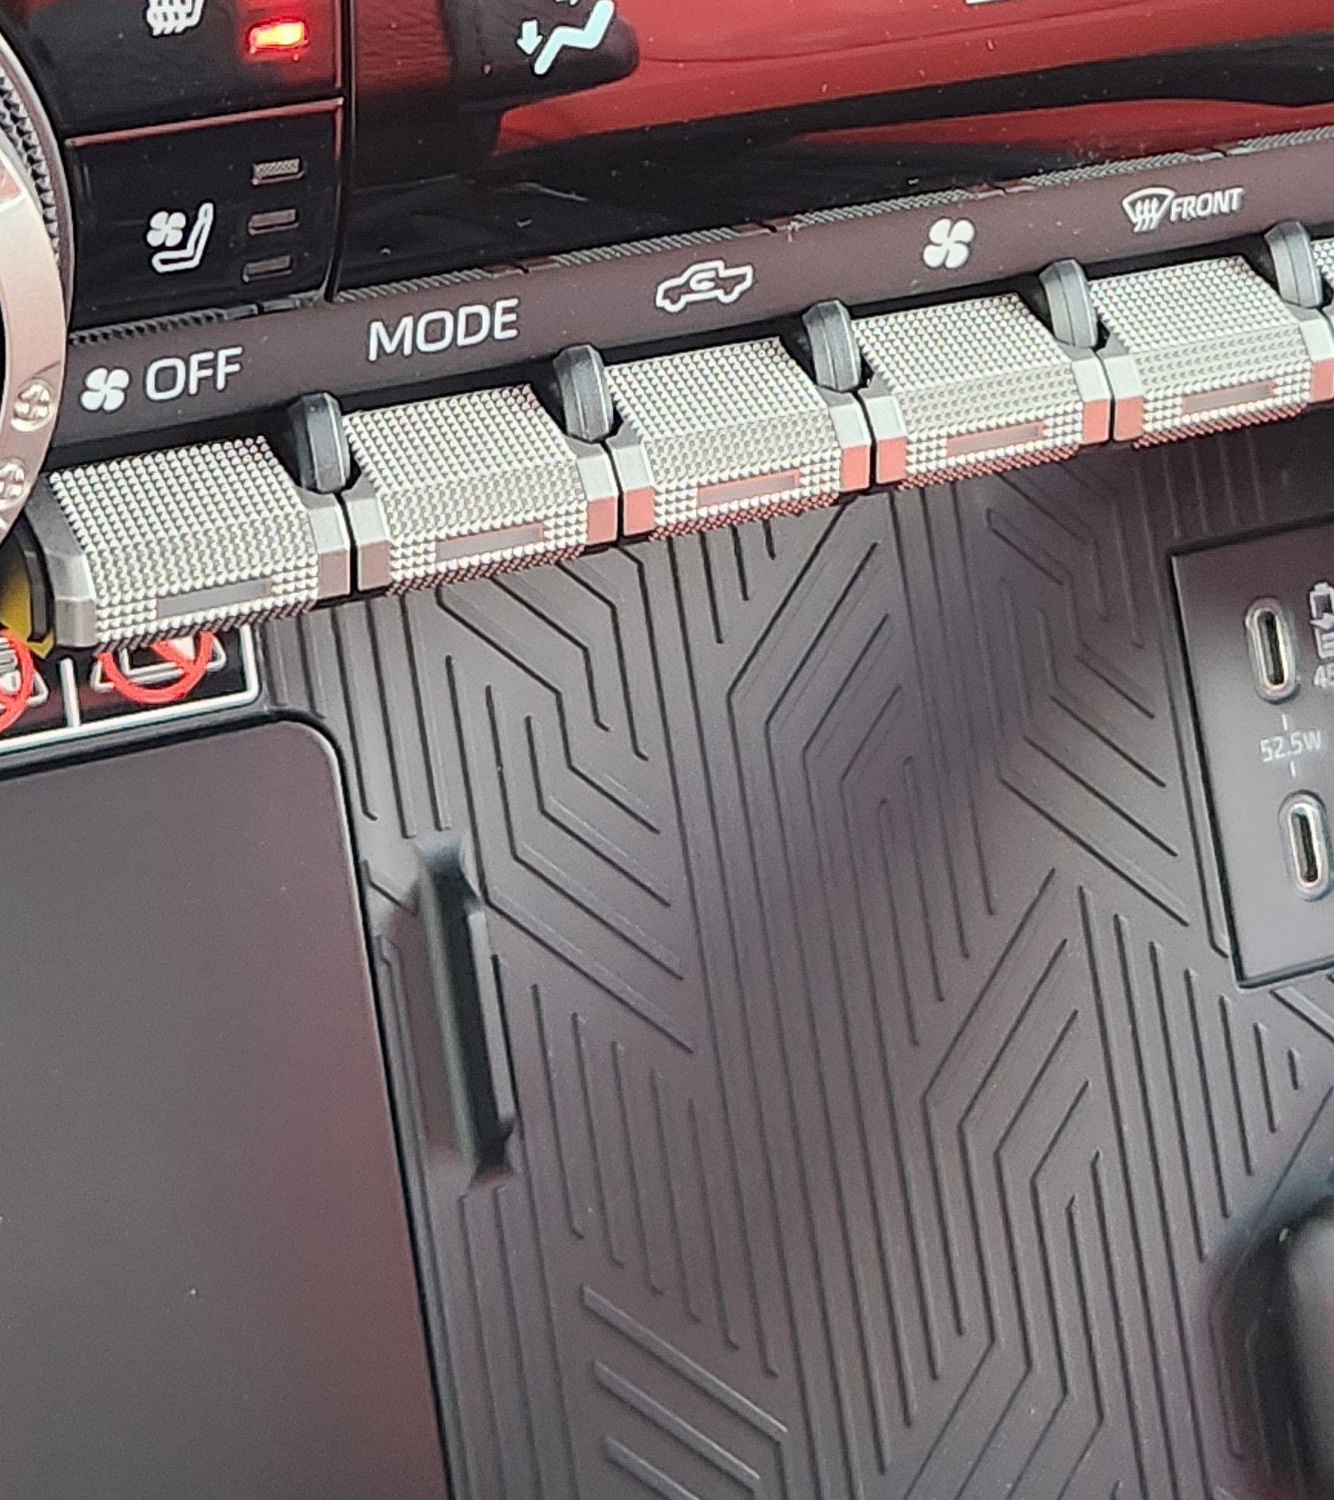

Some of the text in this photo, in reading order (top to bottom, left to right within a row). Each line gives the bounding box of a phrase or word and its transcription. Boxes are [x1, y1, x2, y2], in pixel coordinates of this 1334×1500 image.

[1170, 186, 1245, 222] FRONT
[367, 298, 519, 361] MODE
[145, 346, 243, 402] OFF
[1259, 731, 1323, 763] 52.5W
